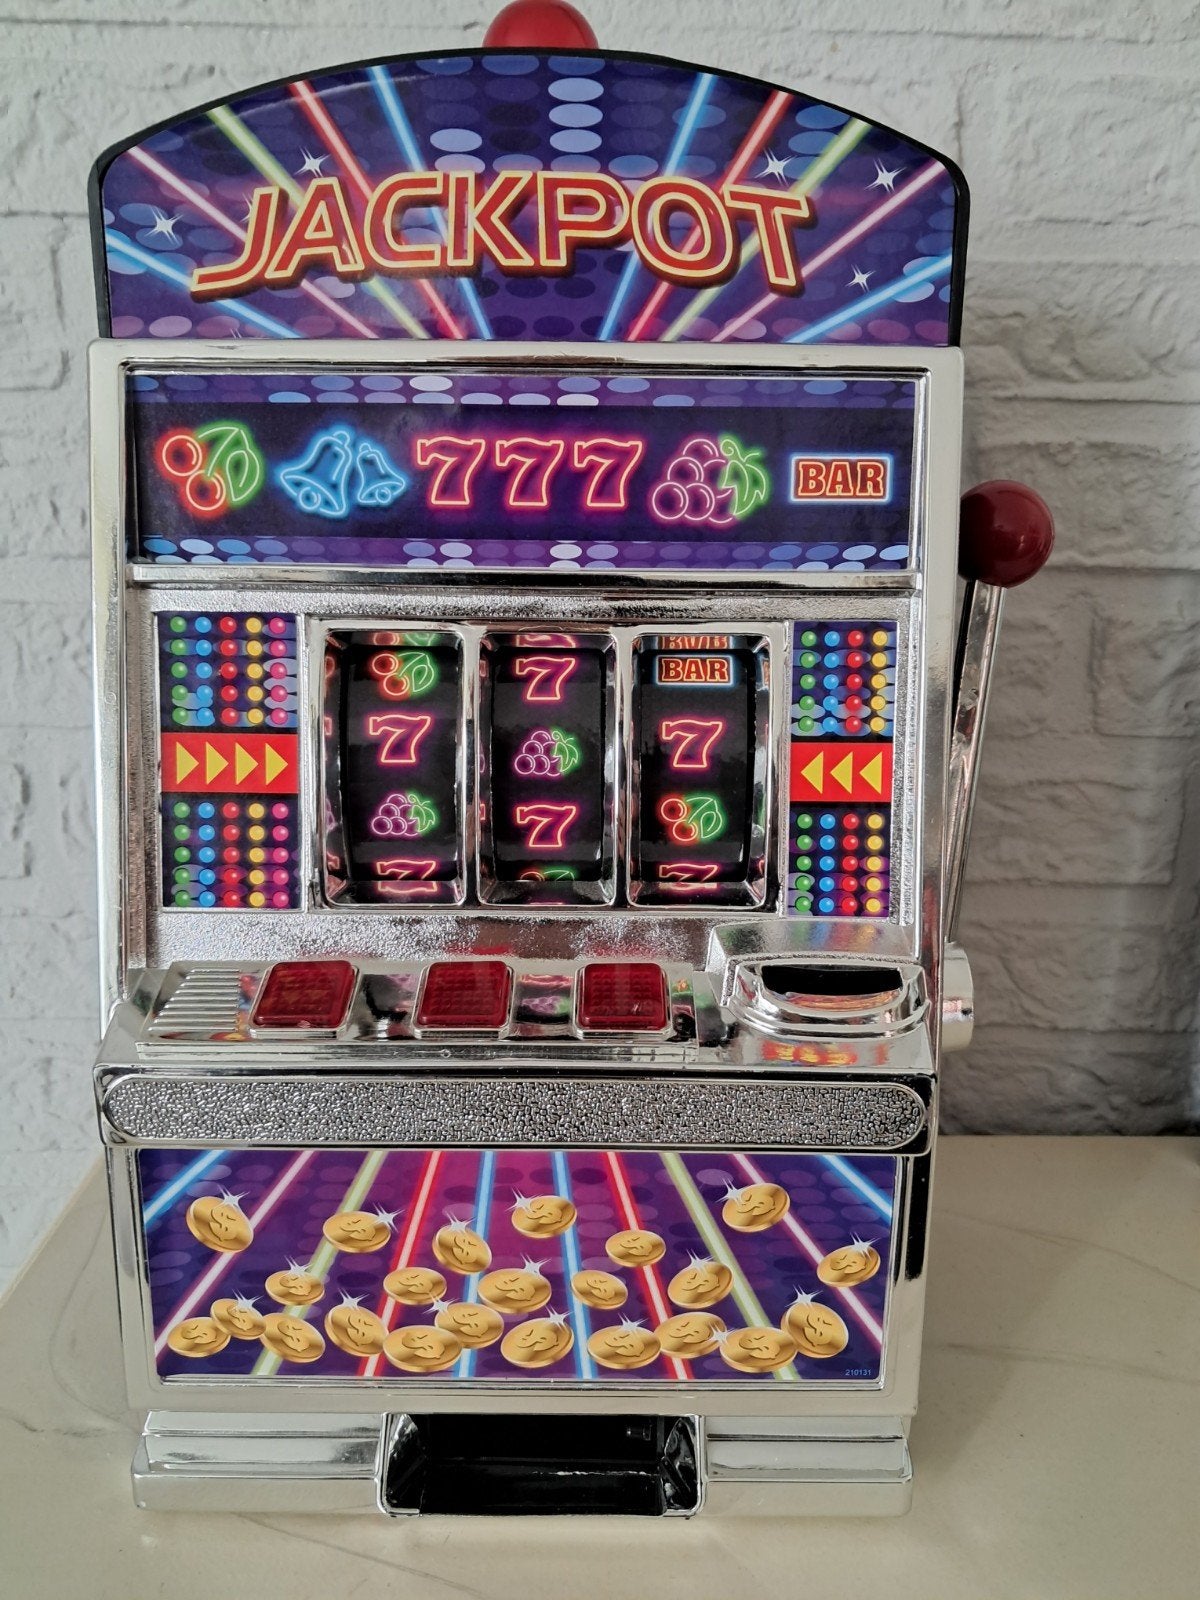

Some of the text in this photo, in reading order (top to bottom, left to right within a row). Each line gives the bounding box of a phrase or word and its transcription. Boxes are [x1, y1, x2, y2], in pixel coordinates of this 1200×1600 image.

[191, 170, 812, 295] JACKPOT
[797, 460, 885, 500] BAR
[660, 656, 729, 683] BAR
[368, 713, 432, 764] 7
[660, 719, 724, 768] 7
[516, 805, 577, 848] 7
